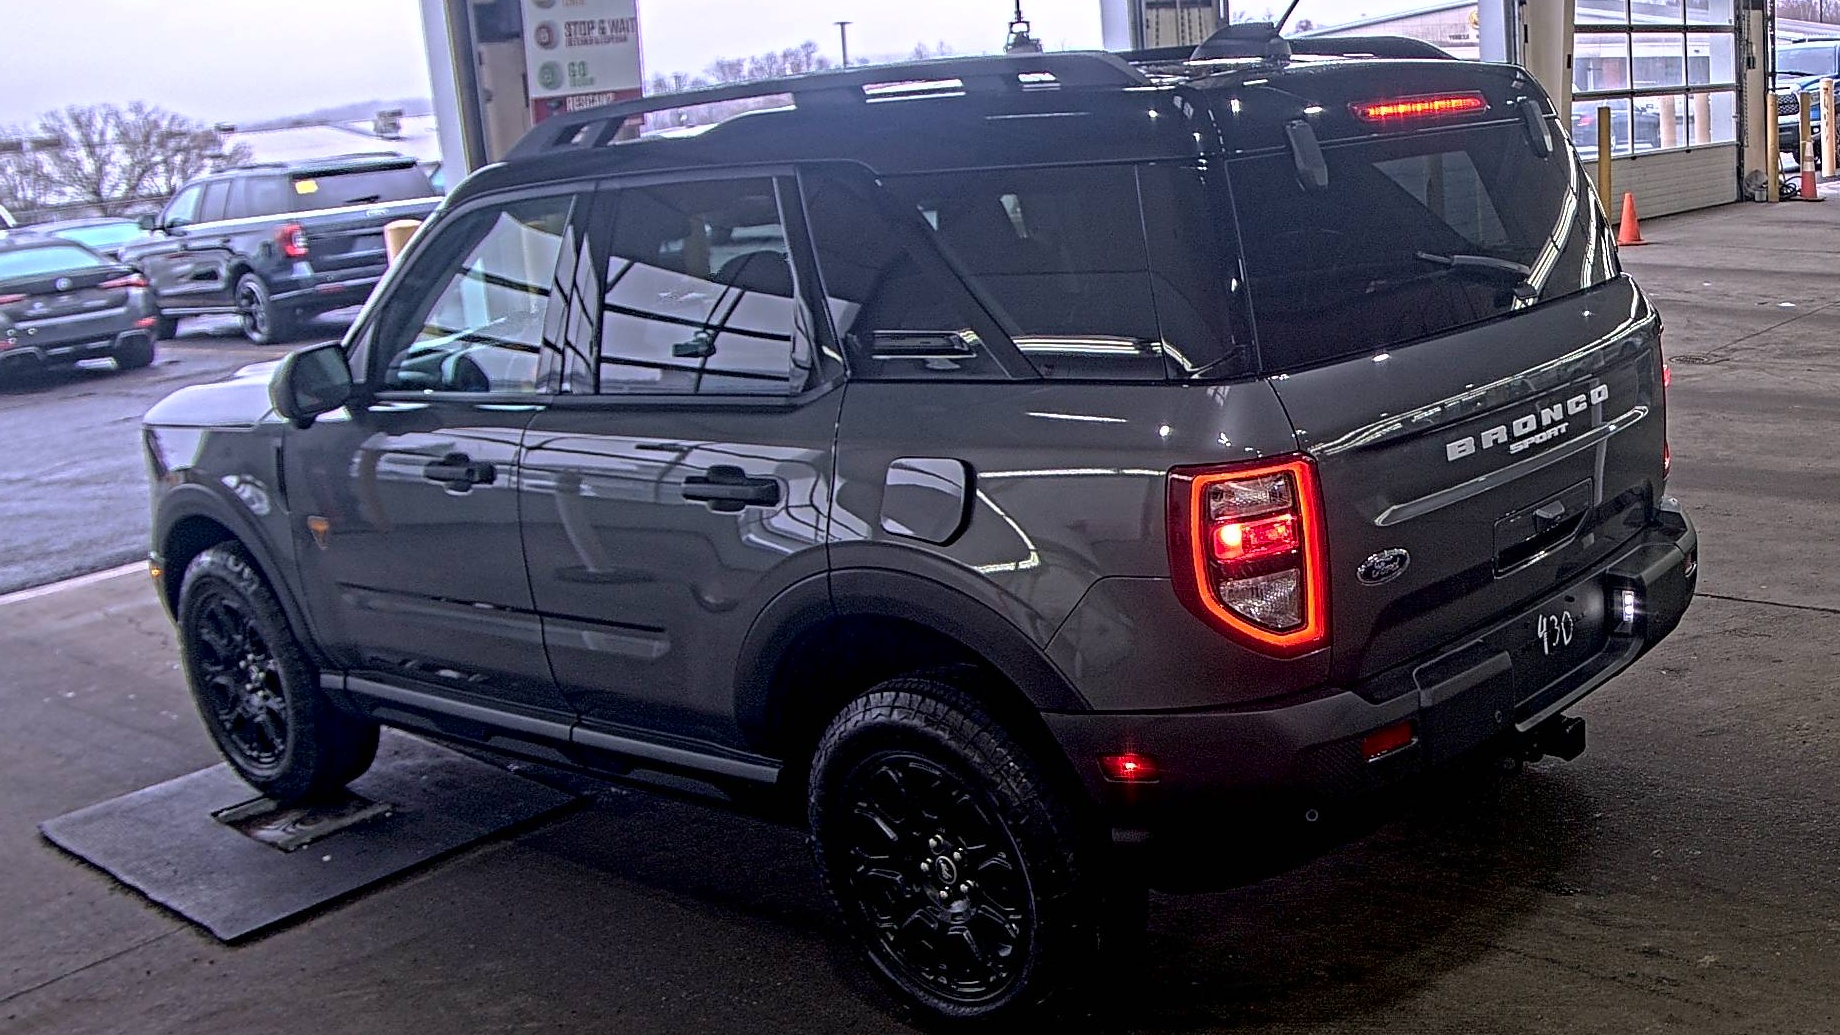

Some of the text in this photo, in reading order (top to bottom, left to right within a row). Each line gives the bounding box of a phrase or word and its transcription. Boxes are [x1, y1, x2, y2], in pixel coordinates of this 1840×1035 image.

[564, 20, 595, 37] STOP
[598, 19, 607, 35] &
[608, 17, 637, 34] WAIT
[567, 60, 588, 78] GO
[1446, 384, 1609, 462] BRONCO
[1509, 422, 1570, 455] SPORT
[1371, 556, 1400, 578] Ford
